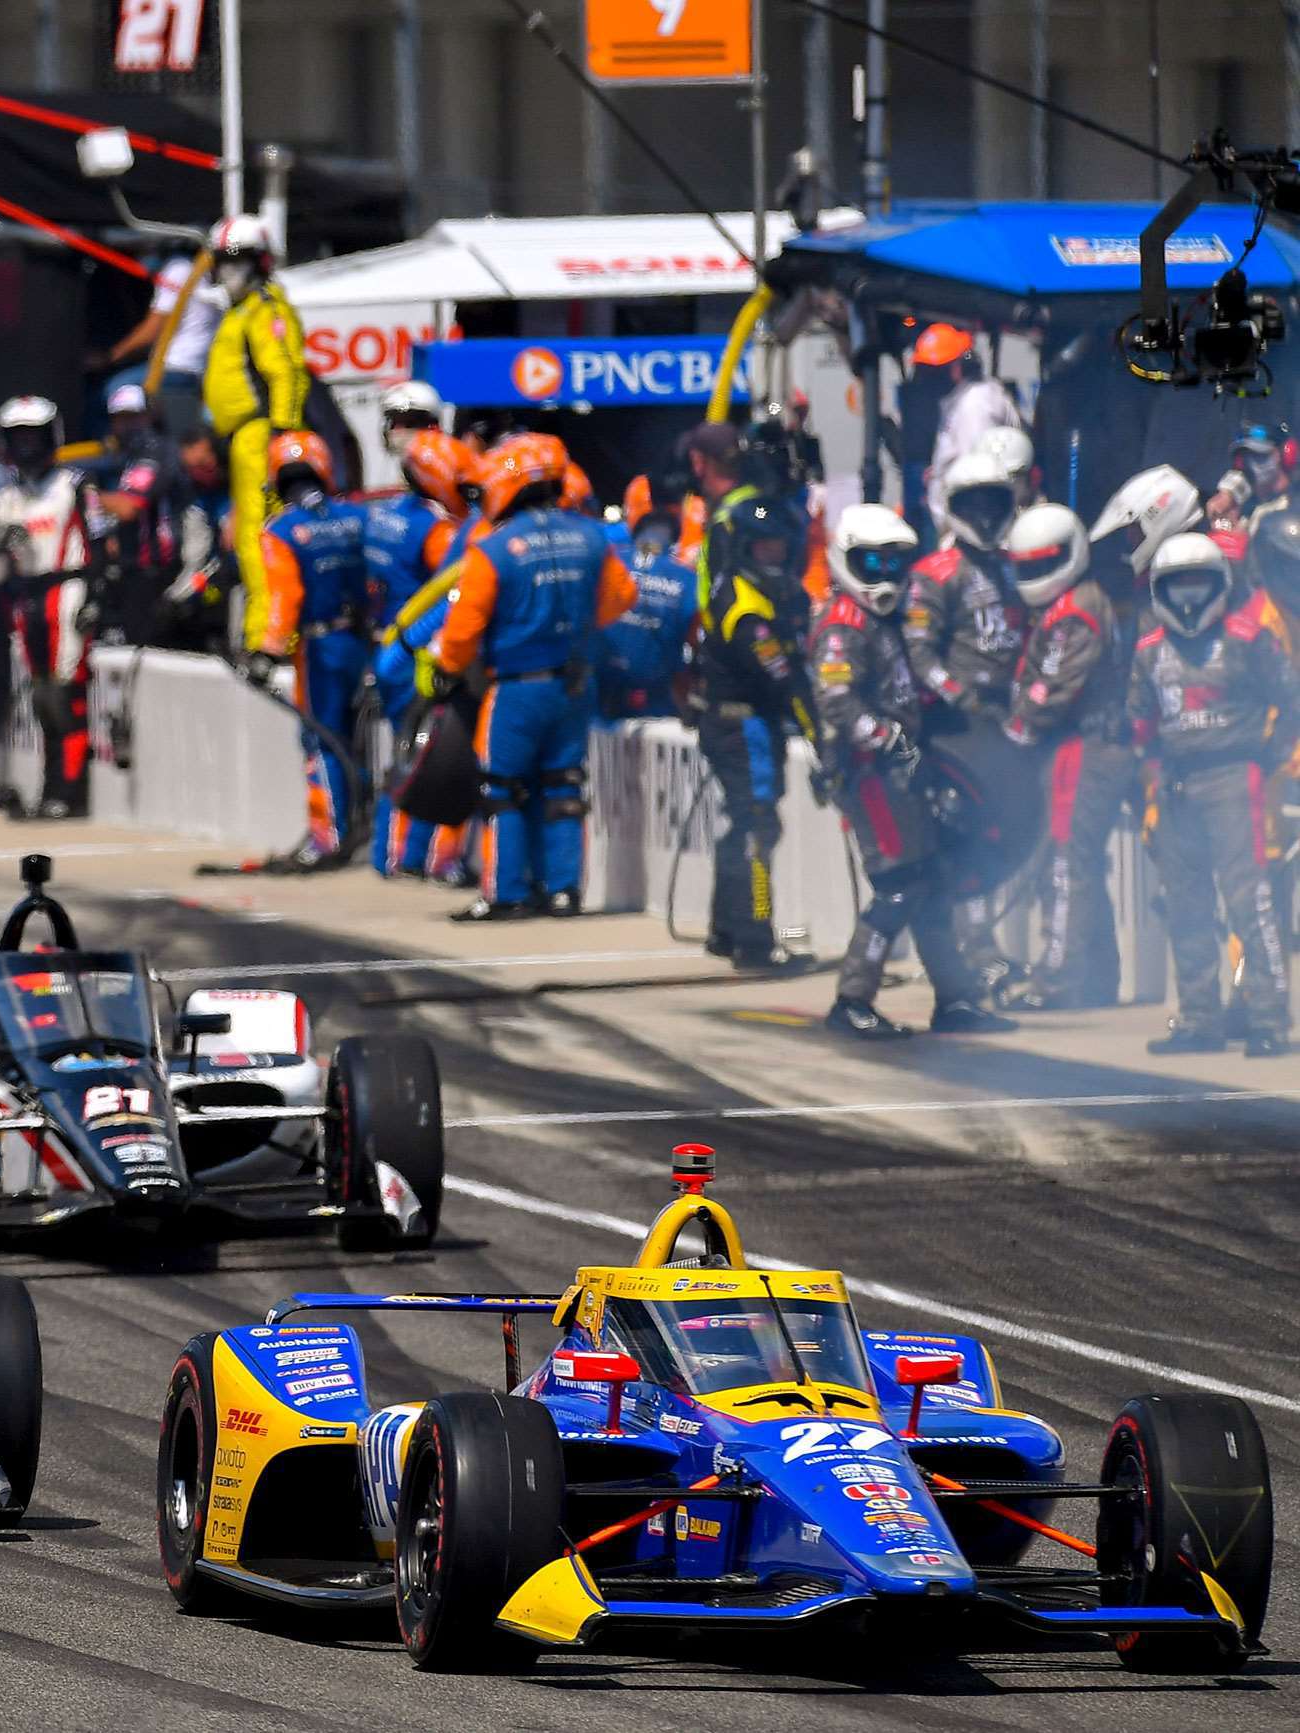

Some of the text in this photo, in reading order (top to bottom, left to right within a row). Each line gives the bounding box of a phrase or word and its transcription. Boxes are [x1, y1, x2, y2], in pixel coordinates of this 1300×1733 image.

[113, 0, 204, 73] 21
[83, 1086, 154, 1120] 21
[279, 1326, 307, 1334] AUTO
[258, 1337, 350, 1350] AutoNation
[874, 1343, 964, 1360] AutoNation
[225, 1408, 263, 1434] DHL
[780, 1421, 894, 1464] 27
[207, 1542, 236, 1557] Firestone
